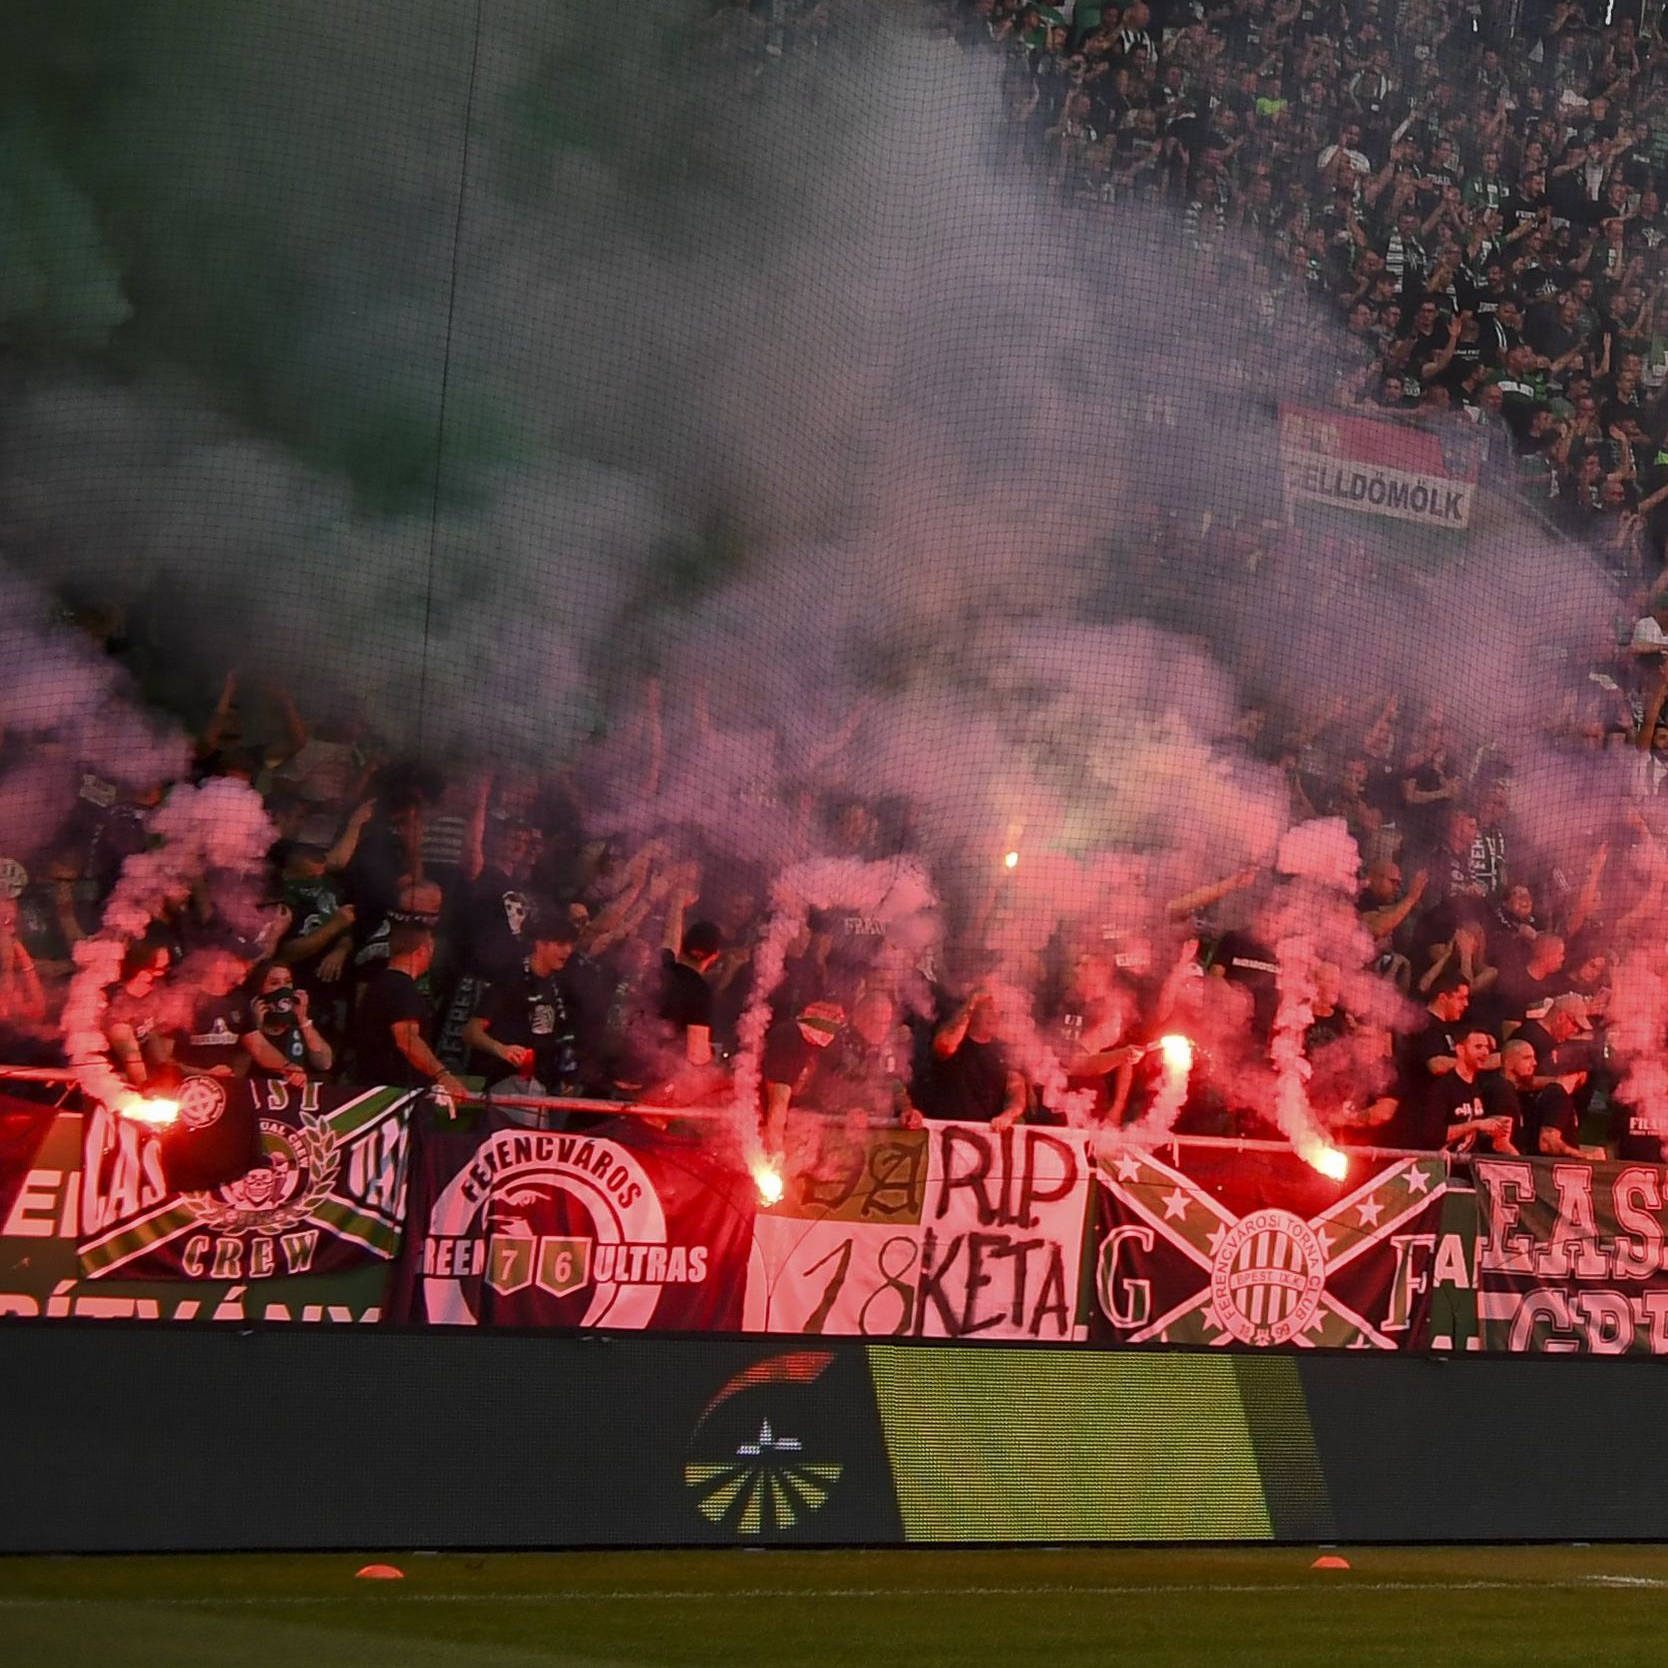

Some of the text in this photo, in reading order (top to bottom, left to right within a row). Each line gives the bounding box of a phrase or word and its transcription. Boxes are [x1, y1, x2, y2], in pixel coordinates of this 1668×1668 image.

[1303, 462, 1465, 521] ELLDÖMÖLK
[182, 1230, 320, 1280] CREW
[593, 1245, 708, 1283] ULTRAS
[1287, 1219, 1320, 1269] TORNA
[914, 1227, 1070, 1338] KETA
[1096, 1225, 1154, 1329] G
[1296, 1275, 1322, 1321] CLUB
